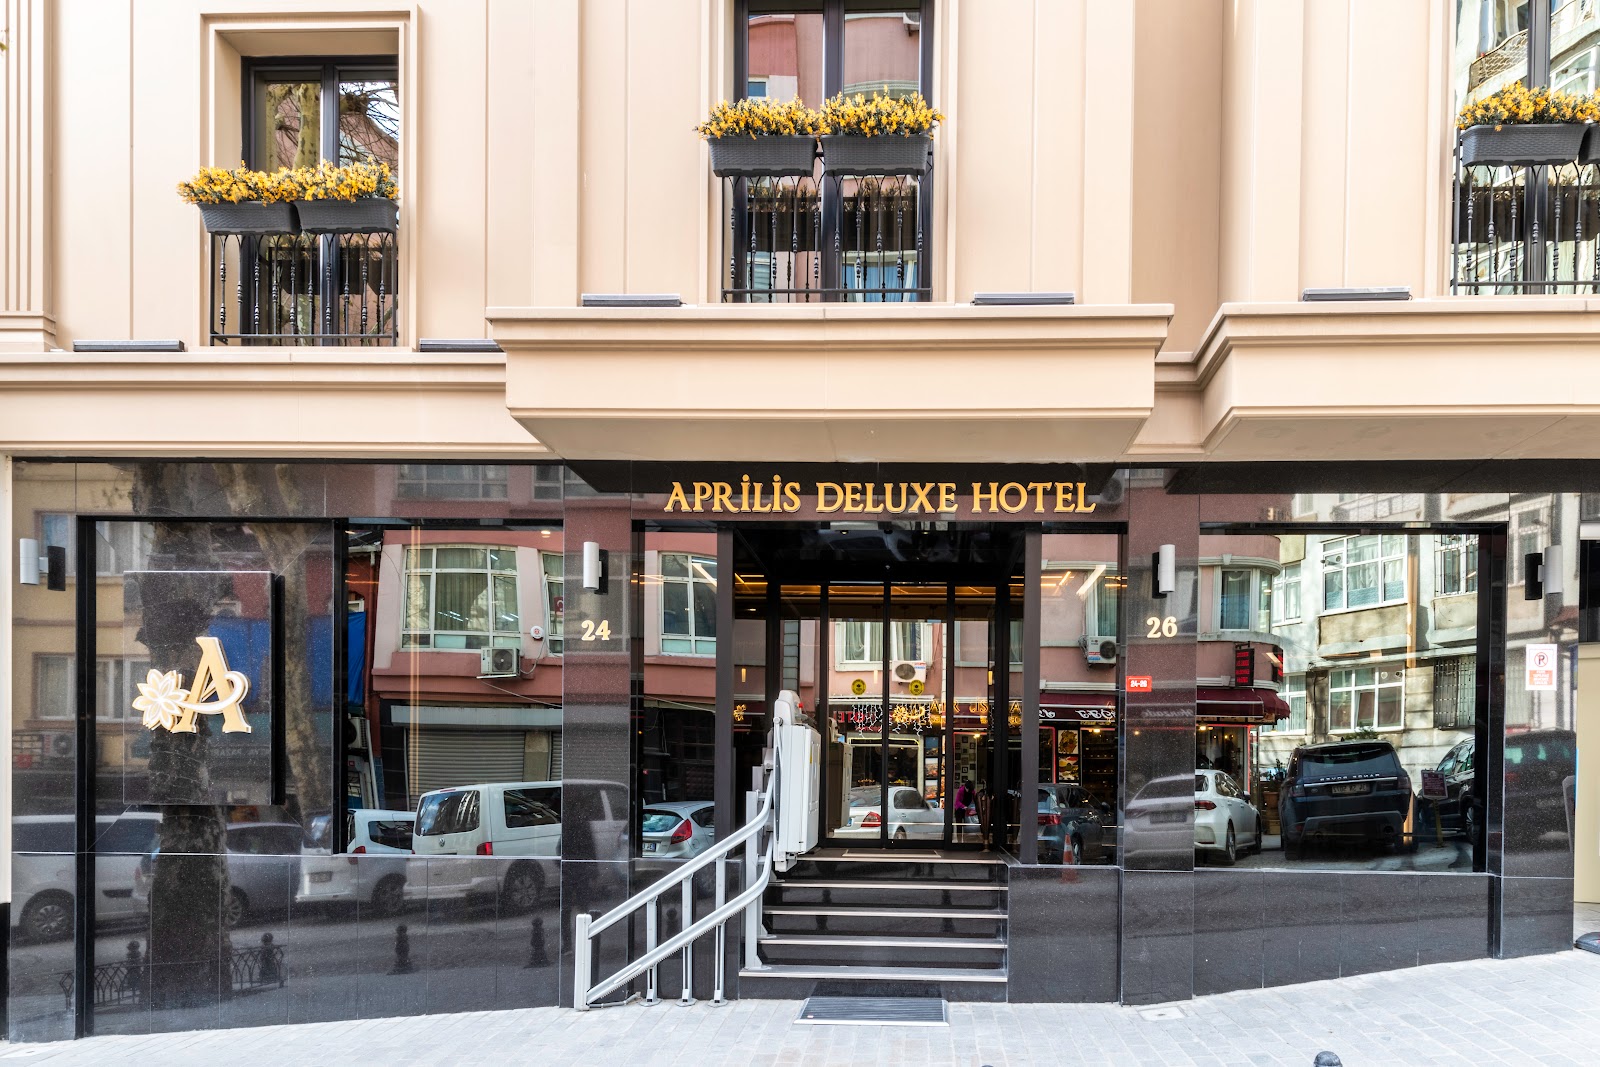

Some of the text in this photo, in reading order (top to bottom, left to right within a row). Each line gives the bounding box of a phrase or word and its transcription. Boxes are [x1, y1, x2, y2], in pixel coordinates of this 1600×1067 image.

[664, 474, 1097, 514] APRİLİS DELUXE HOTEL
[581, 619, 611, 641] 24
[1146, 616, 1178, 639] 26
